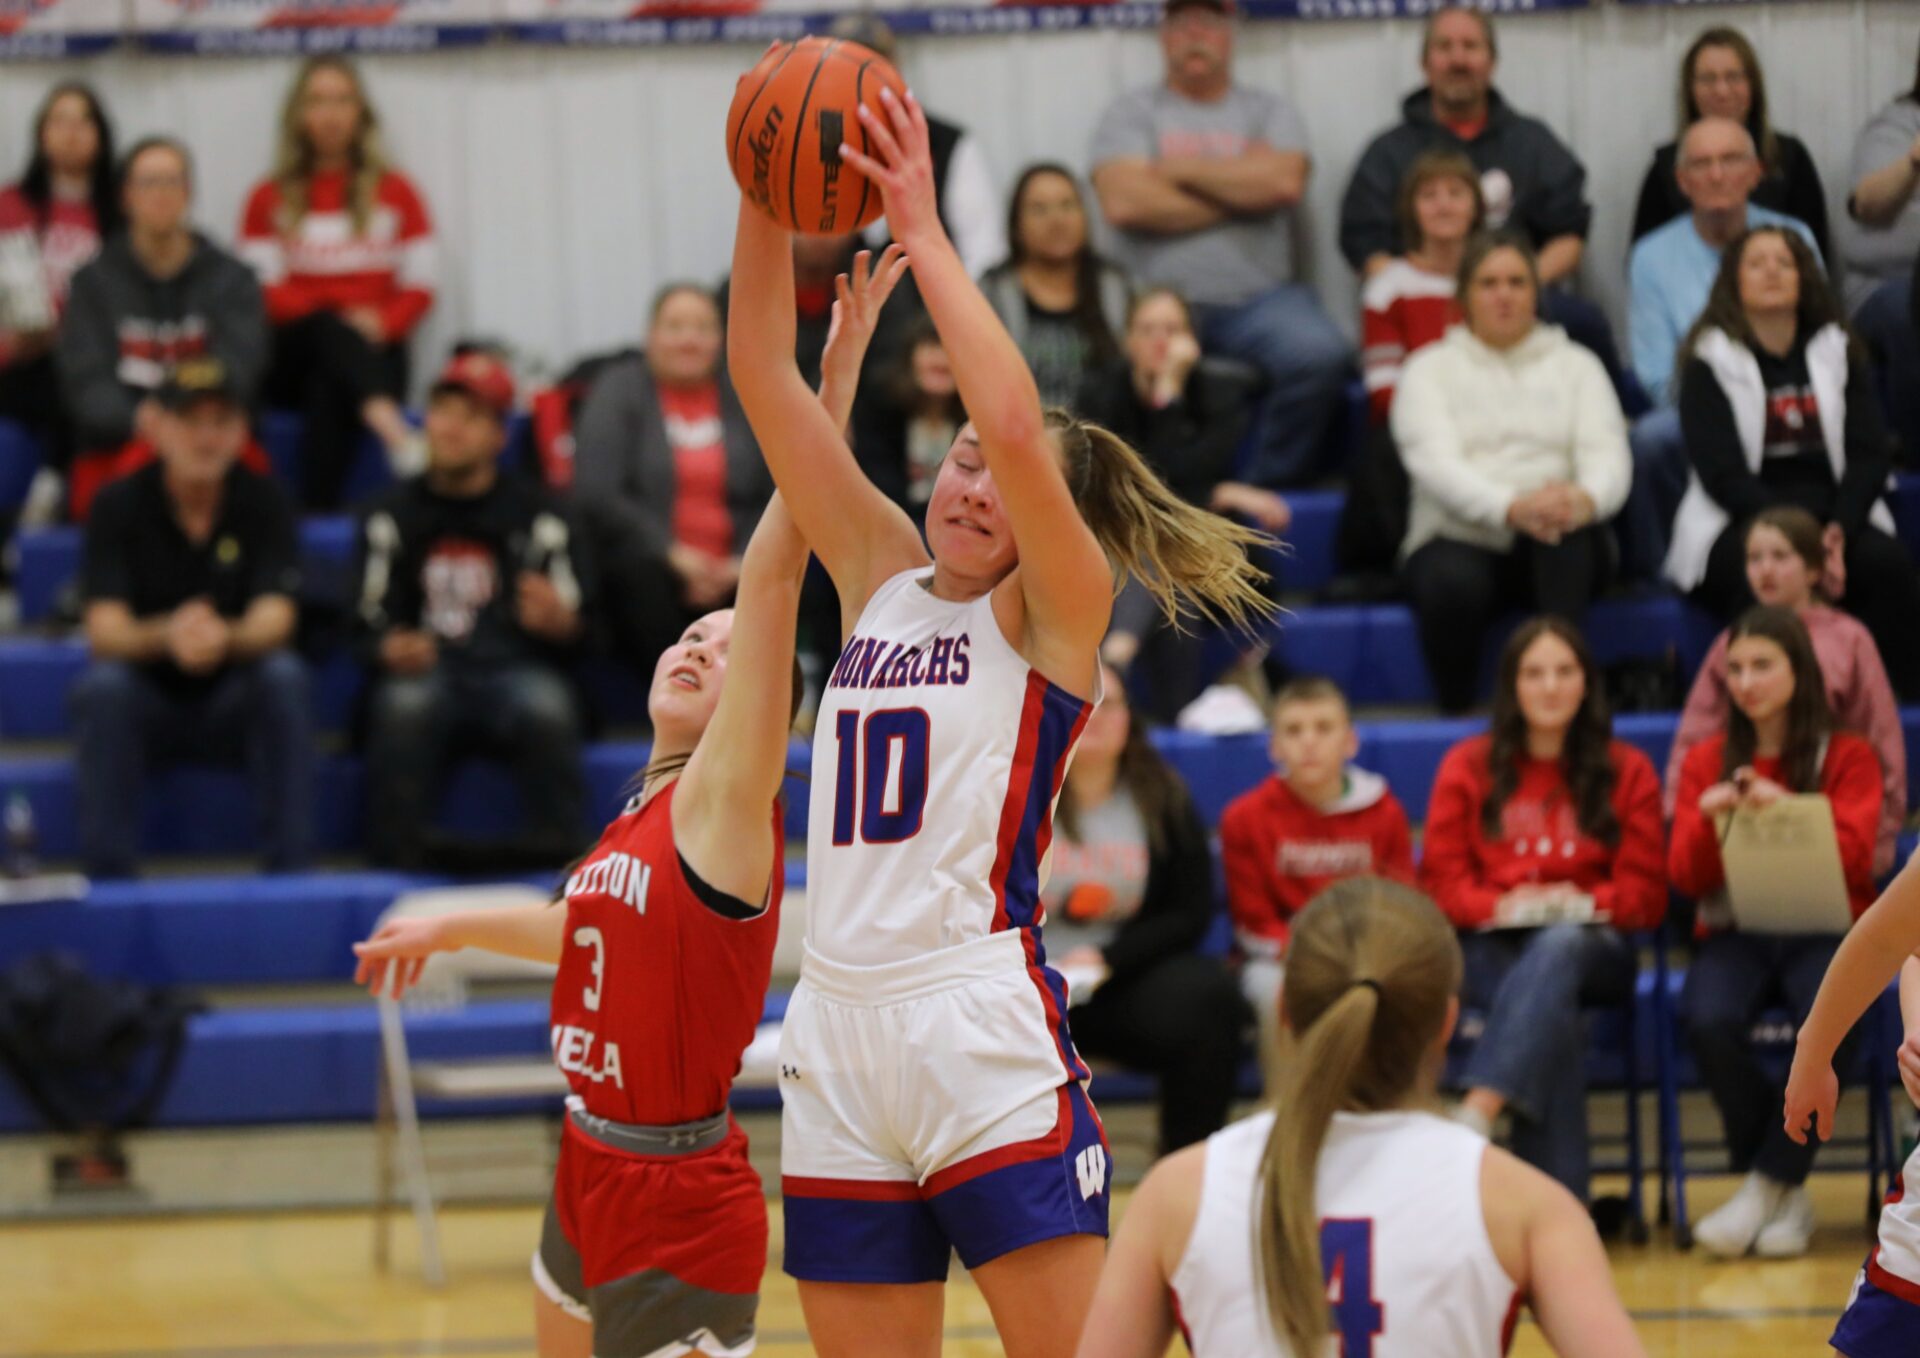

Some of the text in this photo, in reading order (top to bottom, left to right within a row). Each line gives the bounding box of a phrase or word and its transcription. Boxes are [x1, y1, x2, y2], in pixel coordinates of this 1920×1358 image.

[832, 707, 931, 846] 10
[573, 926, 604, 1012] 3
[1075, 1143, 1106, 1202] W
